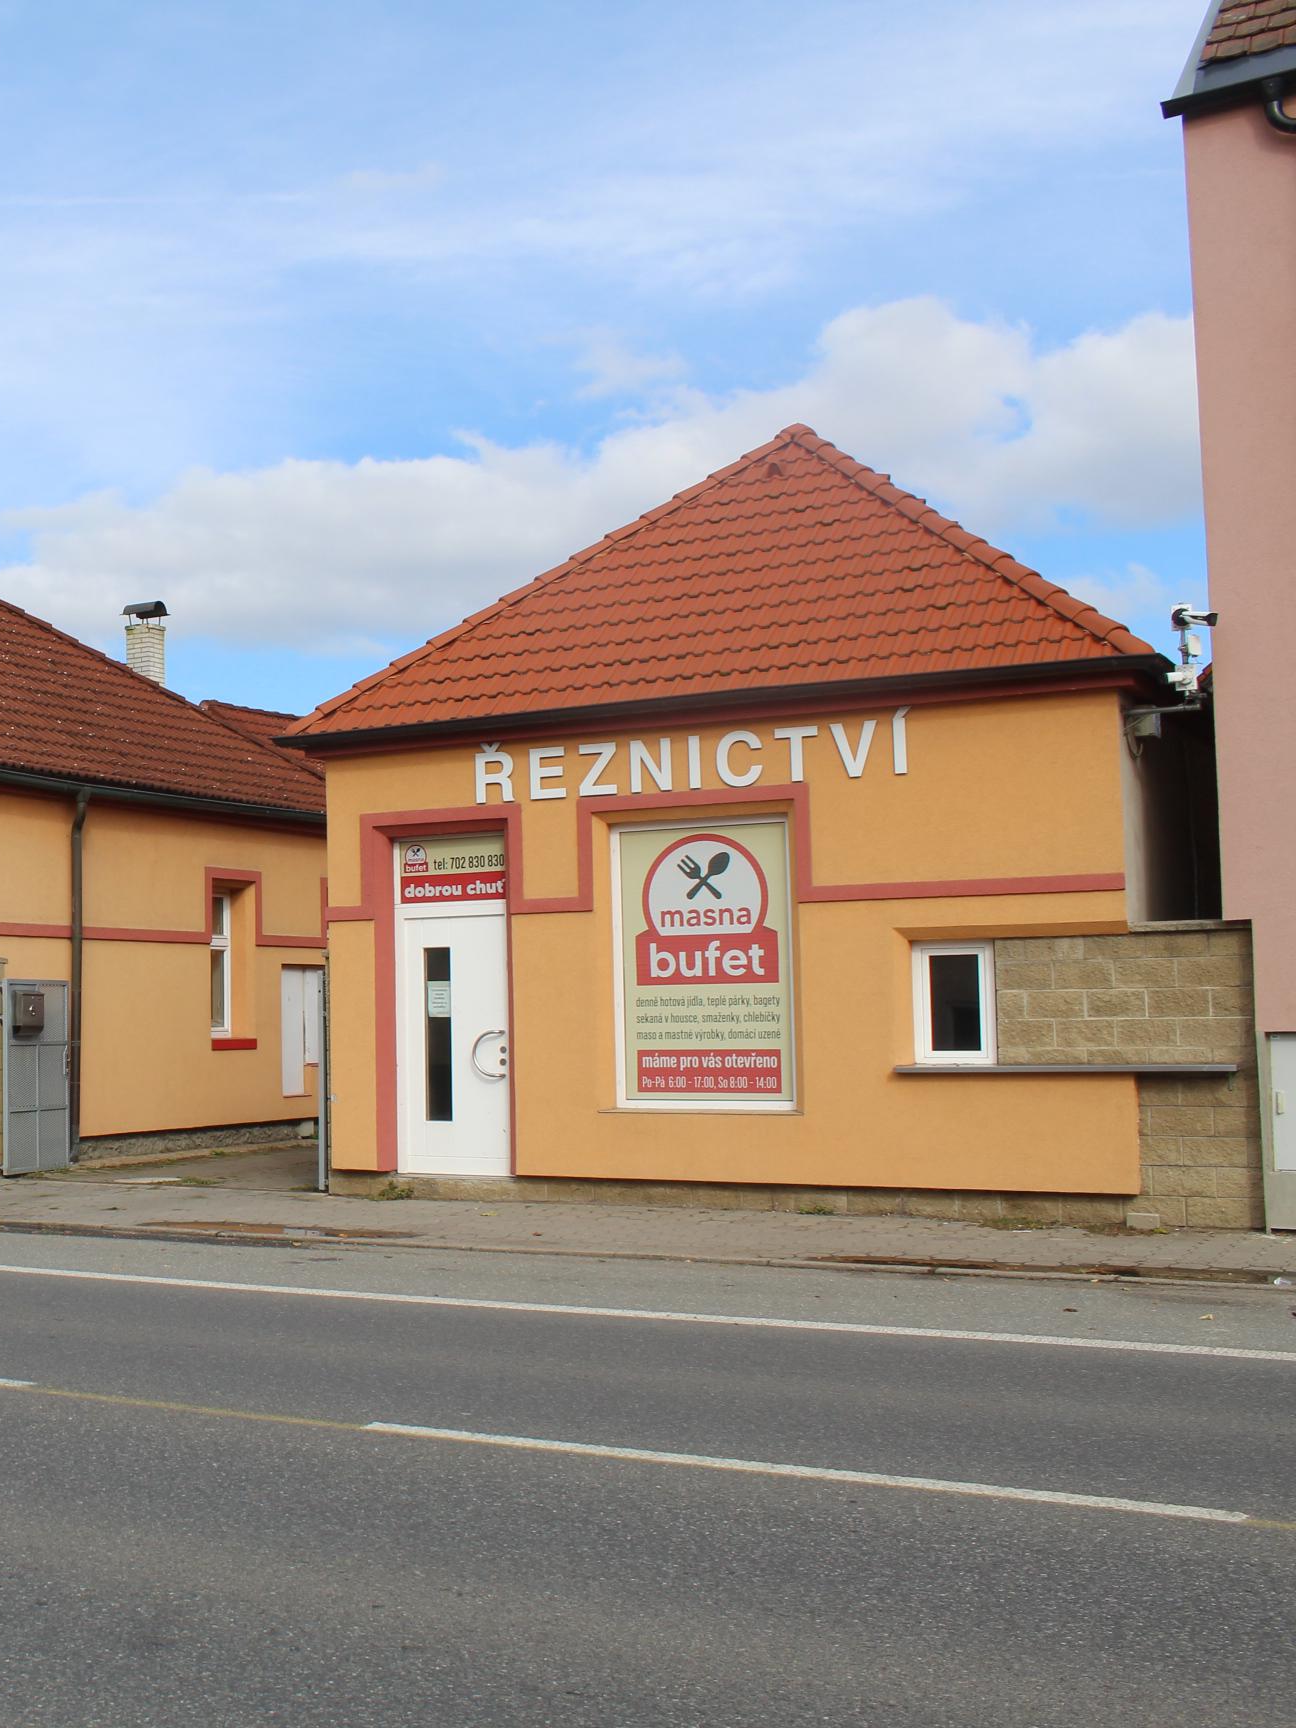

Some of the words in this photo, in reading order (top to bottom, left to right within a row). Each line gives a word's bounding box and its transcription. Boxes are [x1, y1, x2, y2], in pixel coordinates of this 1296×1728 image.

[475, 706, 911, 803] ŘEZNICTVÍ
[405, 864, 427, 872] bufet
[433, 858, 448, 870] tel:
[450, 856, 466, 869] 702
[468, 855, 485, 868] 830
[487, 854, 504, 867] 830
[404, 882, 462, 898] dobrou
[660, 907, 752, 928] masna
[649, 940, 765, 978] bufet
[636, 997, 658, 1007] denně
[659, 996, 685, 1007] hotová
[707, 995, 726, 1007] teplé
[753, 995, 780, 1007] bagety
[636, 1013, 662, 1023] sekaná
[670, 1013, 699, 1024] housce,
[743, 1011, 780, 1024] chlebíčky
[636, 1031, 656, 1040] maso
[664, 1029, 693, 1040] mastné
[727, 1028, 756, 1040] domácí
[757, 1028, 781, 1040] uzené
[642, 1052, 677, 1068] máme
[679, 1056, 699, 1071] pro
[701, 1052, 722, 1068] vás
[724, 1052, 778, 1068] otevřeno
[642, 1075, 665, 1088] Po-Pá
[668, 1075, 686, 1088] 6:00
[718, 1076, 729, 1089] So
[729, 1076, 748, 1089] 8:00
[755, 1076, 777, 1089] 14:00
